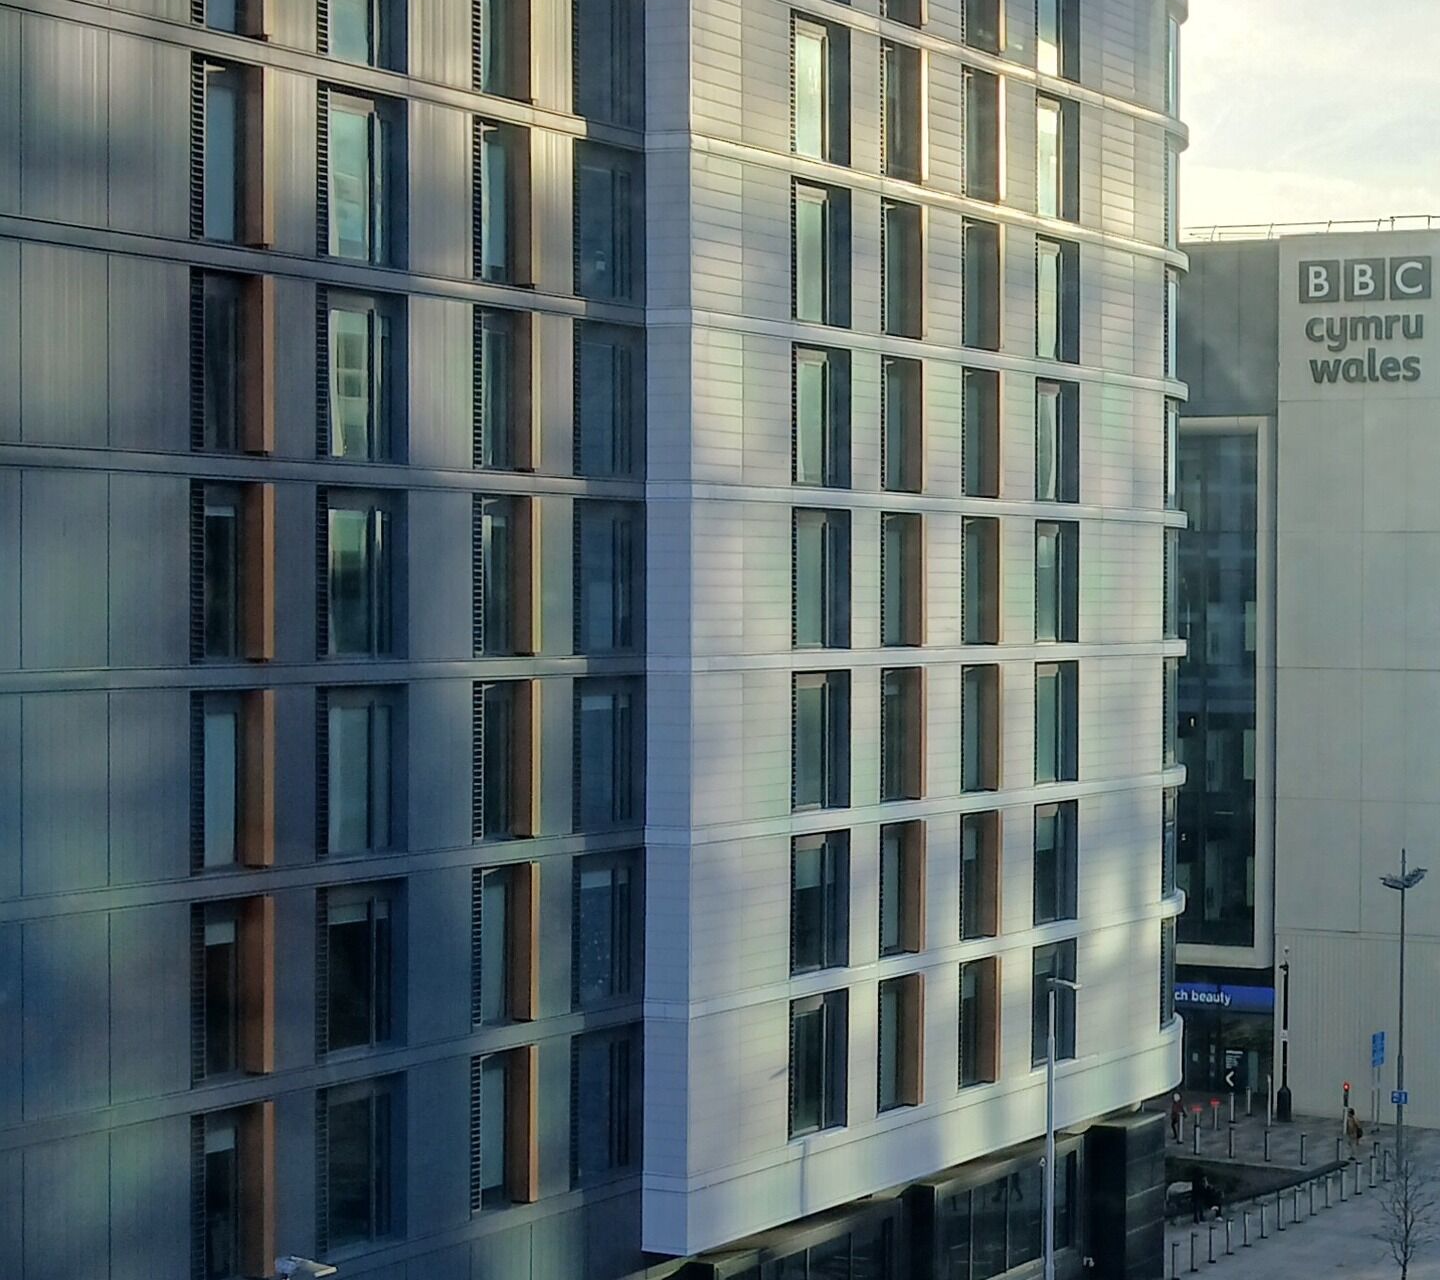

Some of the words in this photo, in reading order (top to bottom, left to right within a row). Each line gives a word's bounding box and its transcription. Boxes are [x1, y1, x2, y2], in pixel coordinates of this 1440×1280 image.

[1303, 258, 1428, 300] BBC
[1305, 314, 1424, 352] cymru
[1309, 347, 1421, 384] wales
[1191, 989, 1232, 1007] beauty
